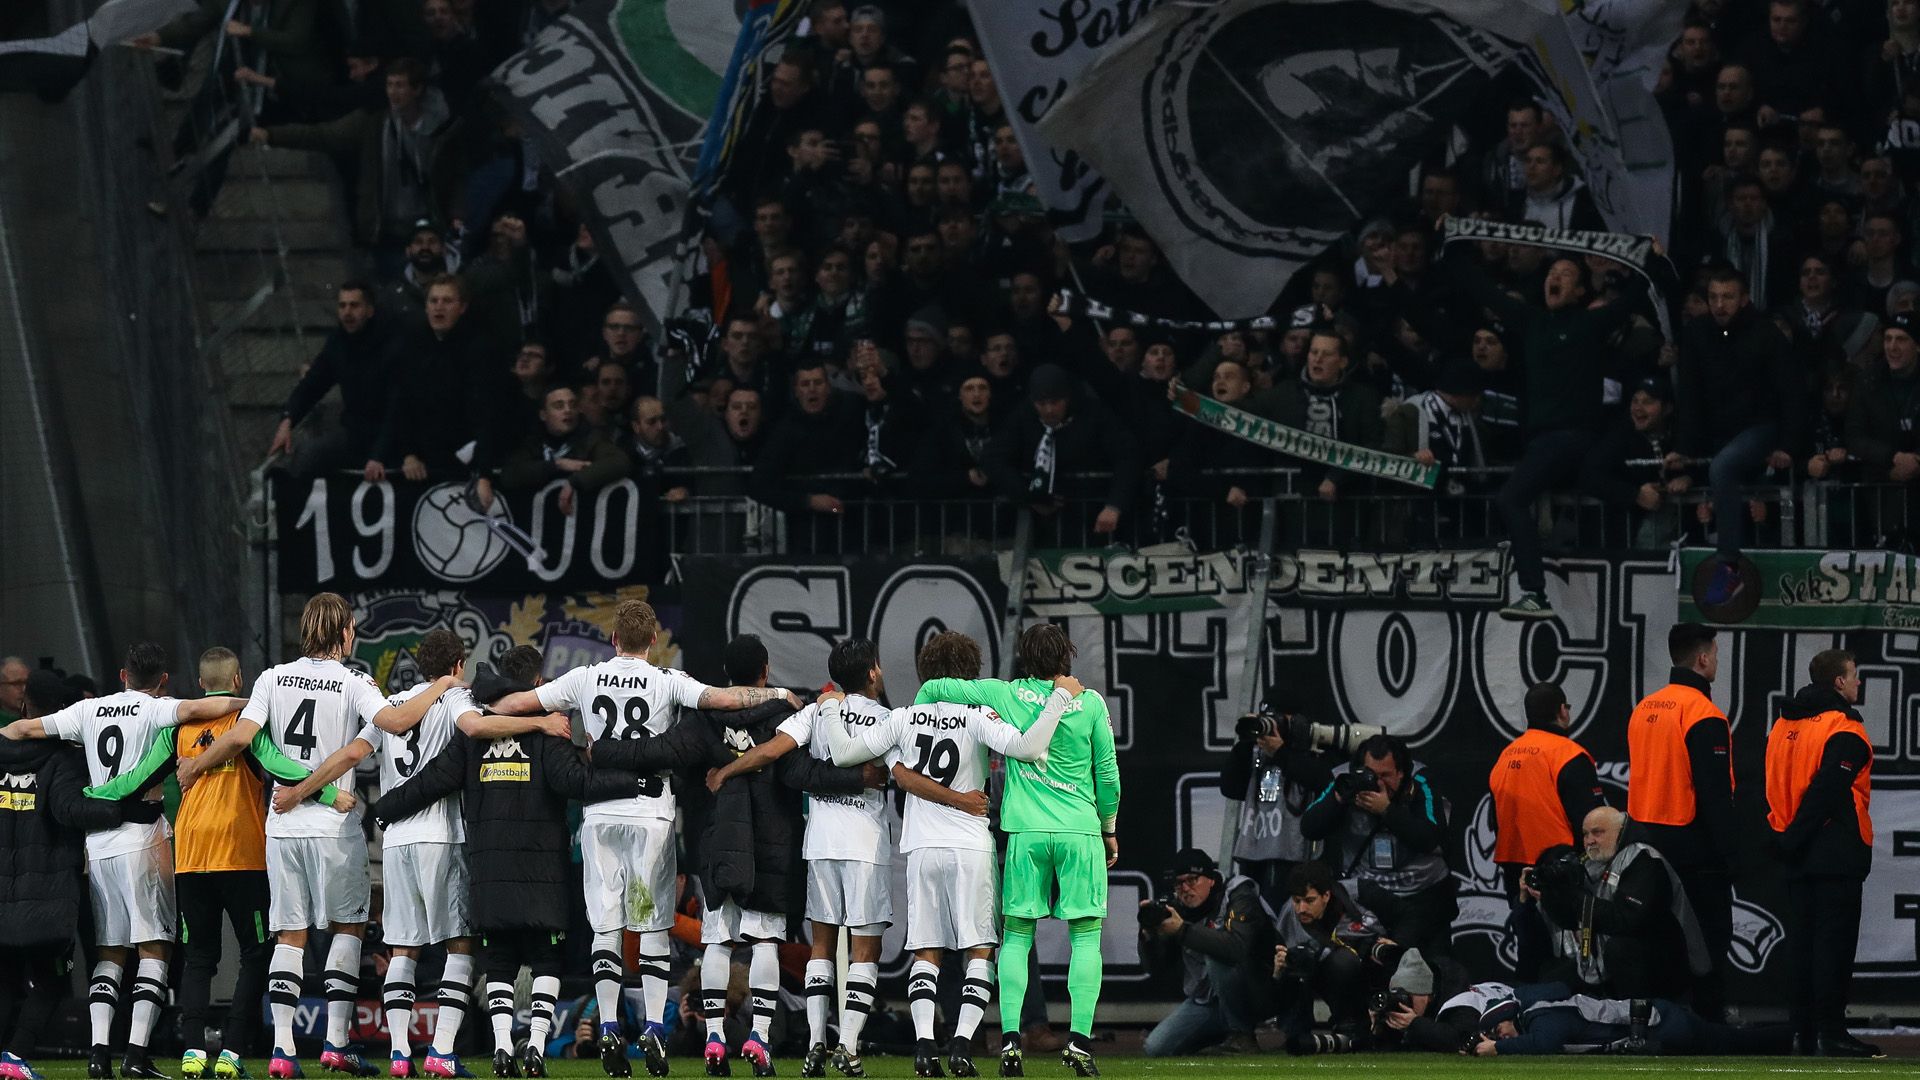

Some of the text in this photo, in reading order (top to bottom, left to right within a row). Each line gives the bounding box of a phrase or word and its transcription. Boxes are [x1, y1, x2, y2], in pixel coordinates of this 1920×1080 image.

[1220, 405, 1434, 485] STADIONVERBOT
[1021, 548, 1503, 600] ASCENDENTE
[1819, 551, 1920, 603] STA
[277, 675, 343, 694] VESTERGAARD
[597, 674, 648, 690] HAHN
[1016, 687, 1083, 713] SOER
[96, 701, 140, 718] DRMIĆ
[284, 698, 317, 761] 4
[592, 694, 650, 741] 28
[819, 709, 876, 727] HOUD
[97, 724, 124, 784] 9
[913, 733, 960, 788] 19
